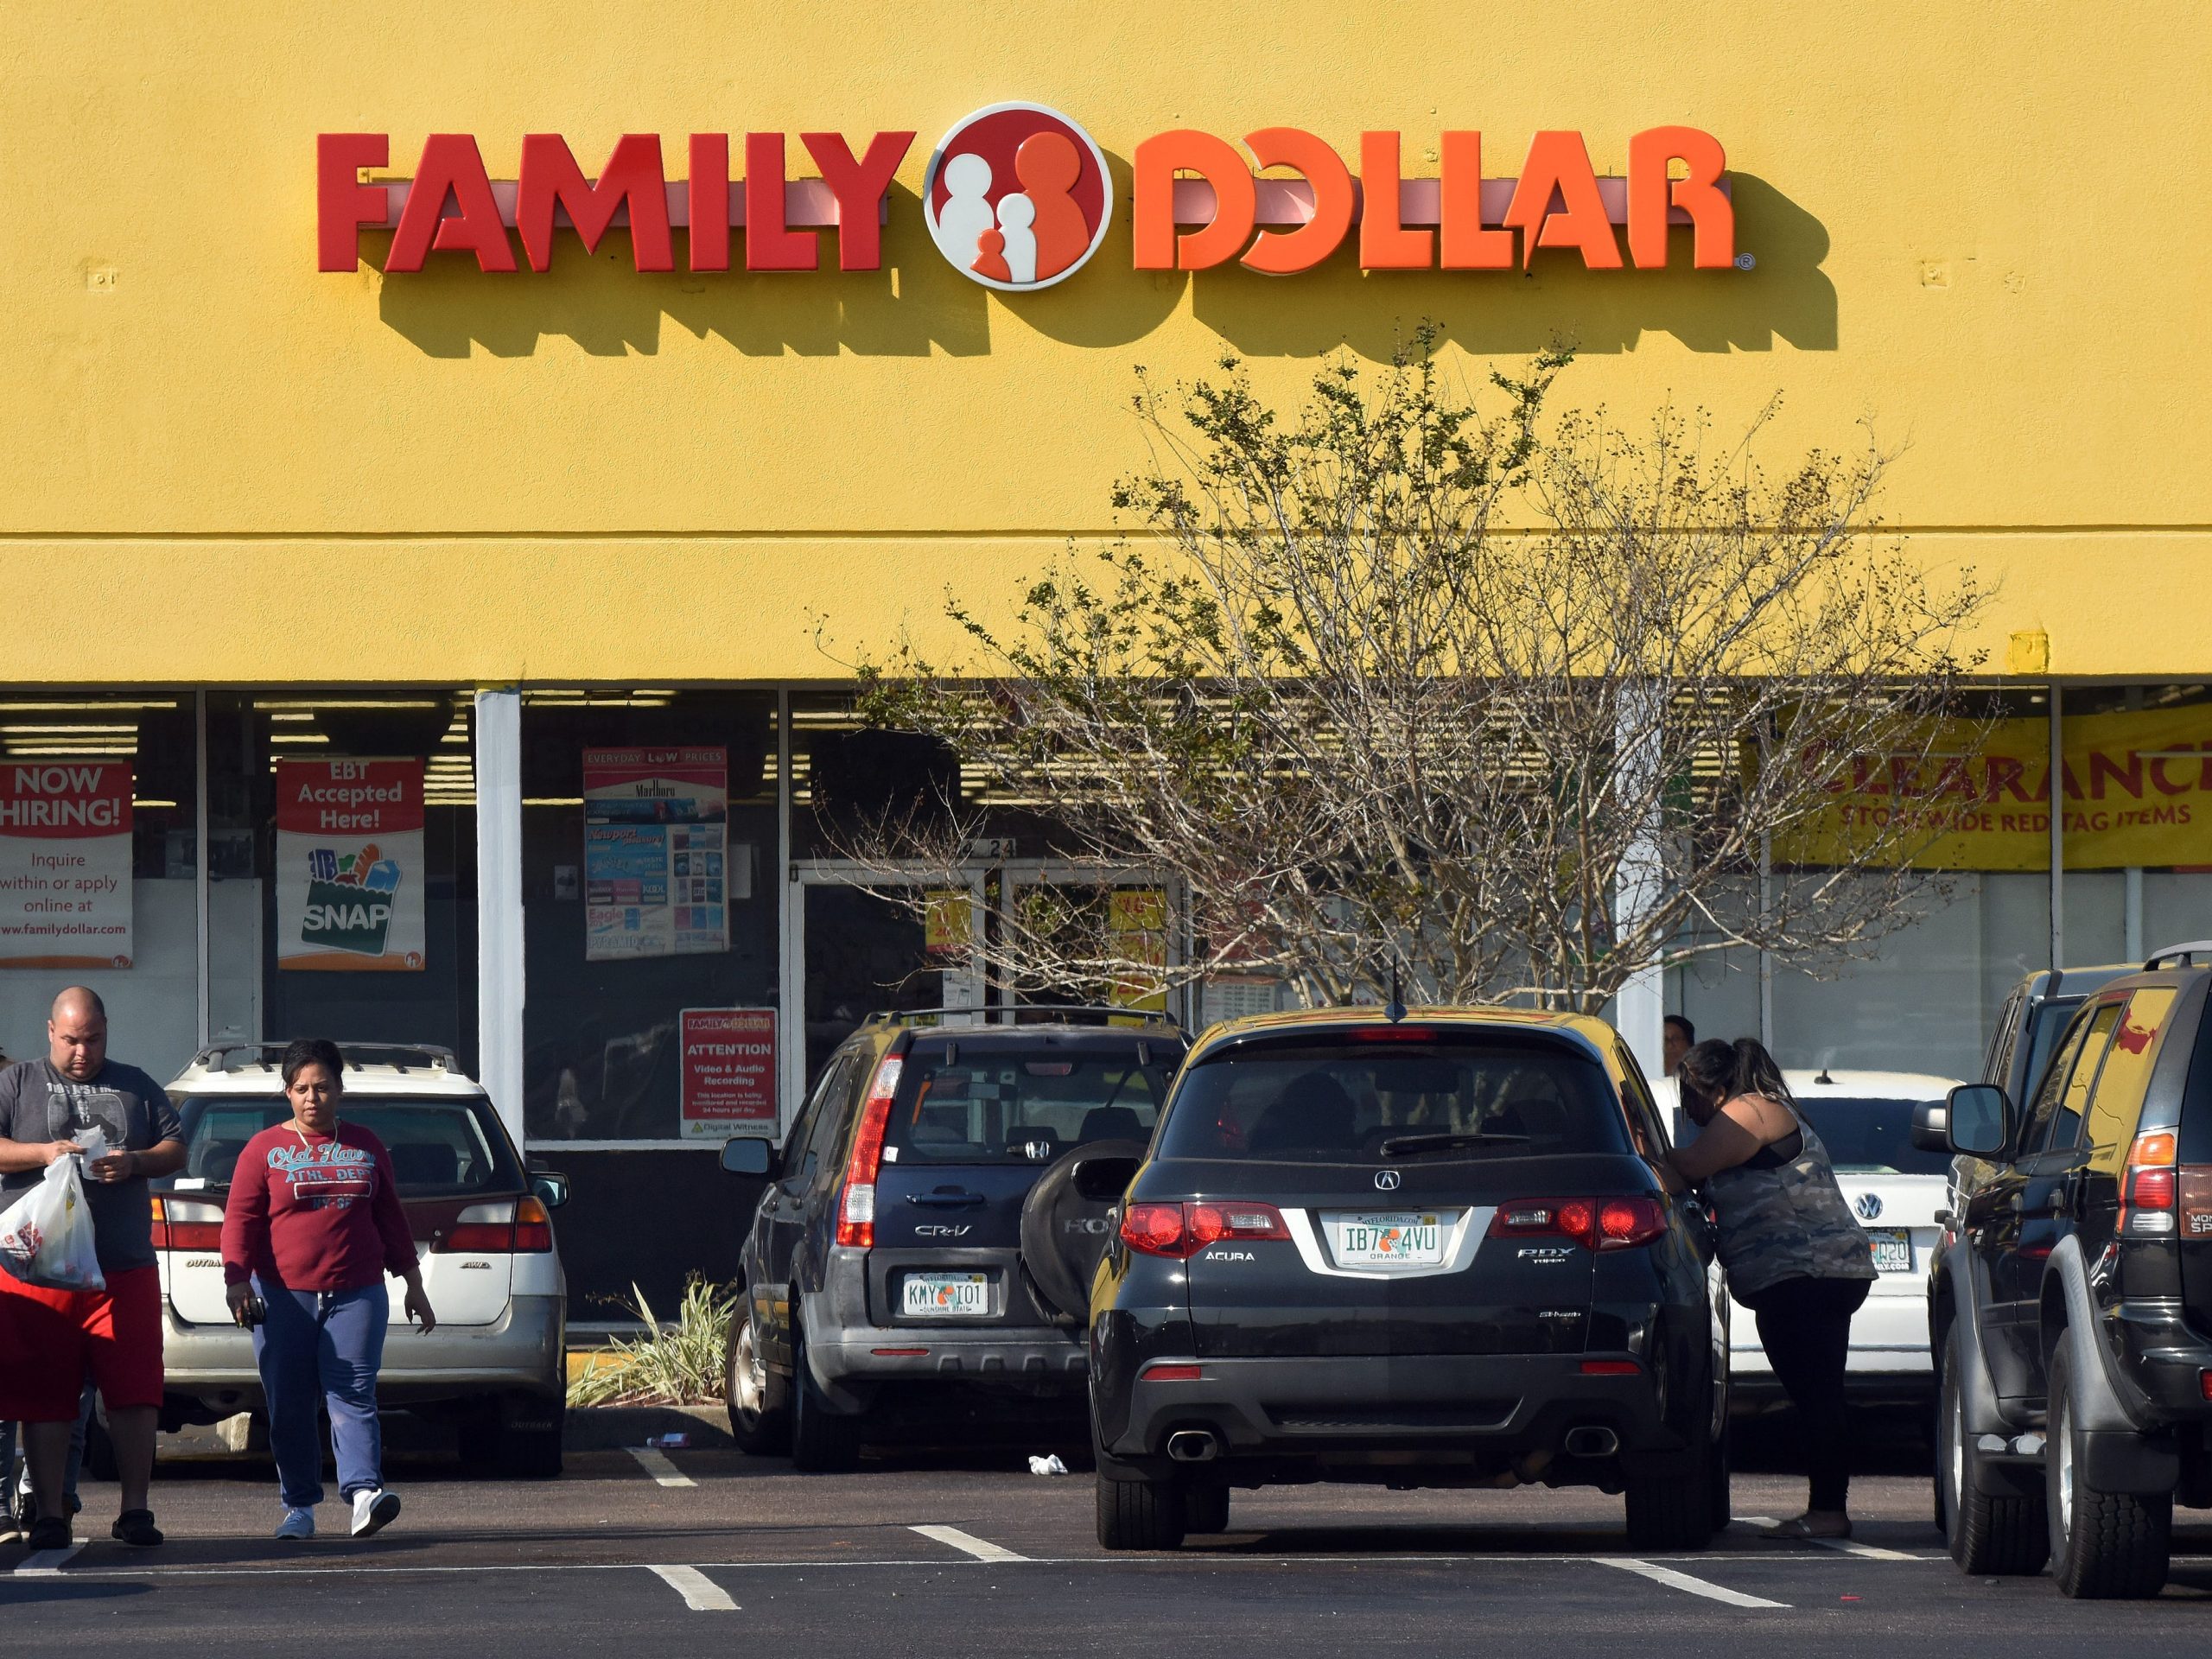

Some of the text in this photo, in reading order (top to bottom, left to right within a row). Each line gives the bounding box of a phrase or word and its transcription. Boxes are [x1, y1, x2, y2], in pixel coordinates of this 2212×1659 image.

[316, 130, 918, 273] FAMILY
[1133, 125, 1735, 272] DOLLAR
[588, 753, 641, 763] EVERYDAY
[685, 752, 721, 761] PRICES
[330, 761, 370, 780] EBT
[15, 767, 103, 794] NOW
[635, 779, 676, 797] Marlboro
[298, 781, 403, 808] Accepted
[0, 798, 120, 827] HIRING!
[321, 810, 380, 829] Here!
[2001, 814, 2050, 832] RED
[2062, 813, 2110, 833] TAG
[2116, 804, 2191, 828] ITEMS
[31, 853, 86, 870] Inquire
[0, 875, 118, 893] within or apply
[24, 899, 92, 912] online at
[302, 904, 390, 931] SNAP
[589, 908, 623, 922] Eagle
[688, 1044, 772, 1056] ATTENTION
[694, 1065, 765, 1073] Video & Audio
[704, 1077, 755, 1087] Recording
[268, 1145, 314, 1167] Old
[915, 1225, 973, 1236] CR-V
[1346, 1227, 1435, 1251] IB7 4VU
[186, 1259, 222, 1268] OUTBA
[1205, 1251, 1255, 1262] ACURA
[909, 1285, 936, 1306] KMY
